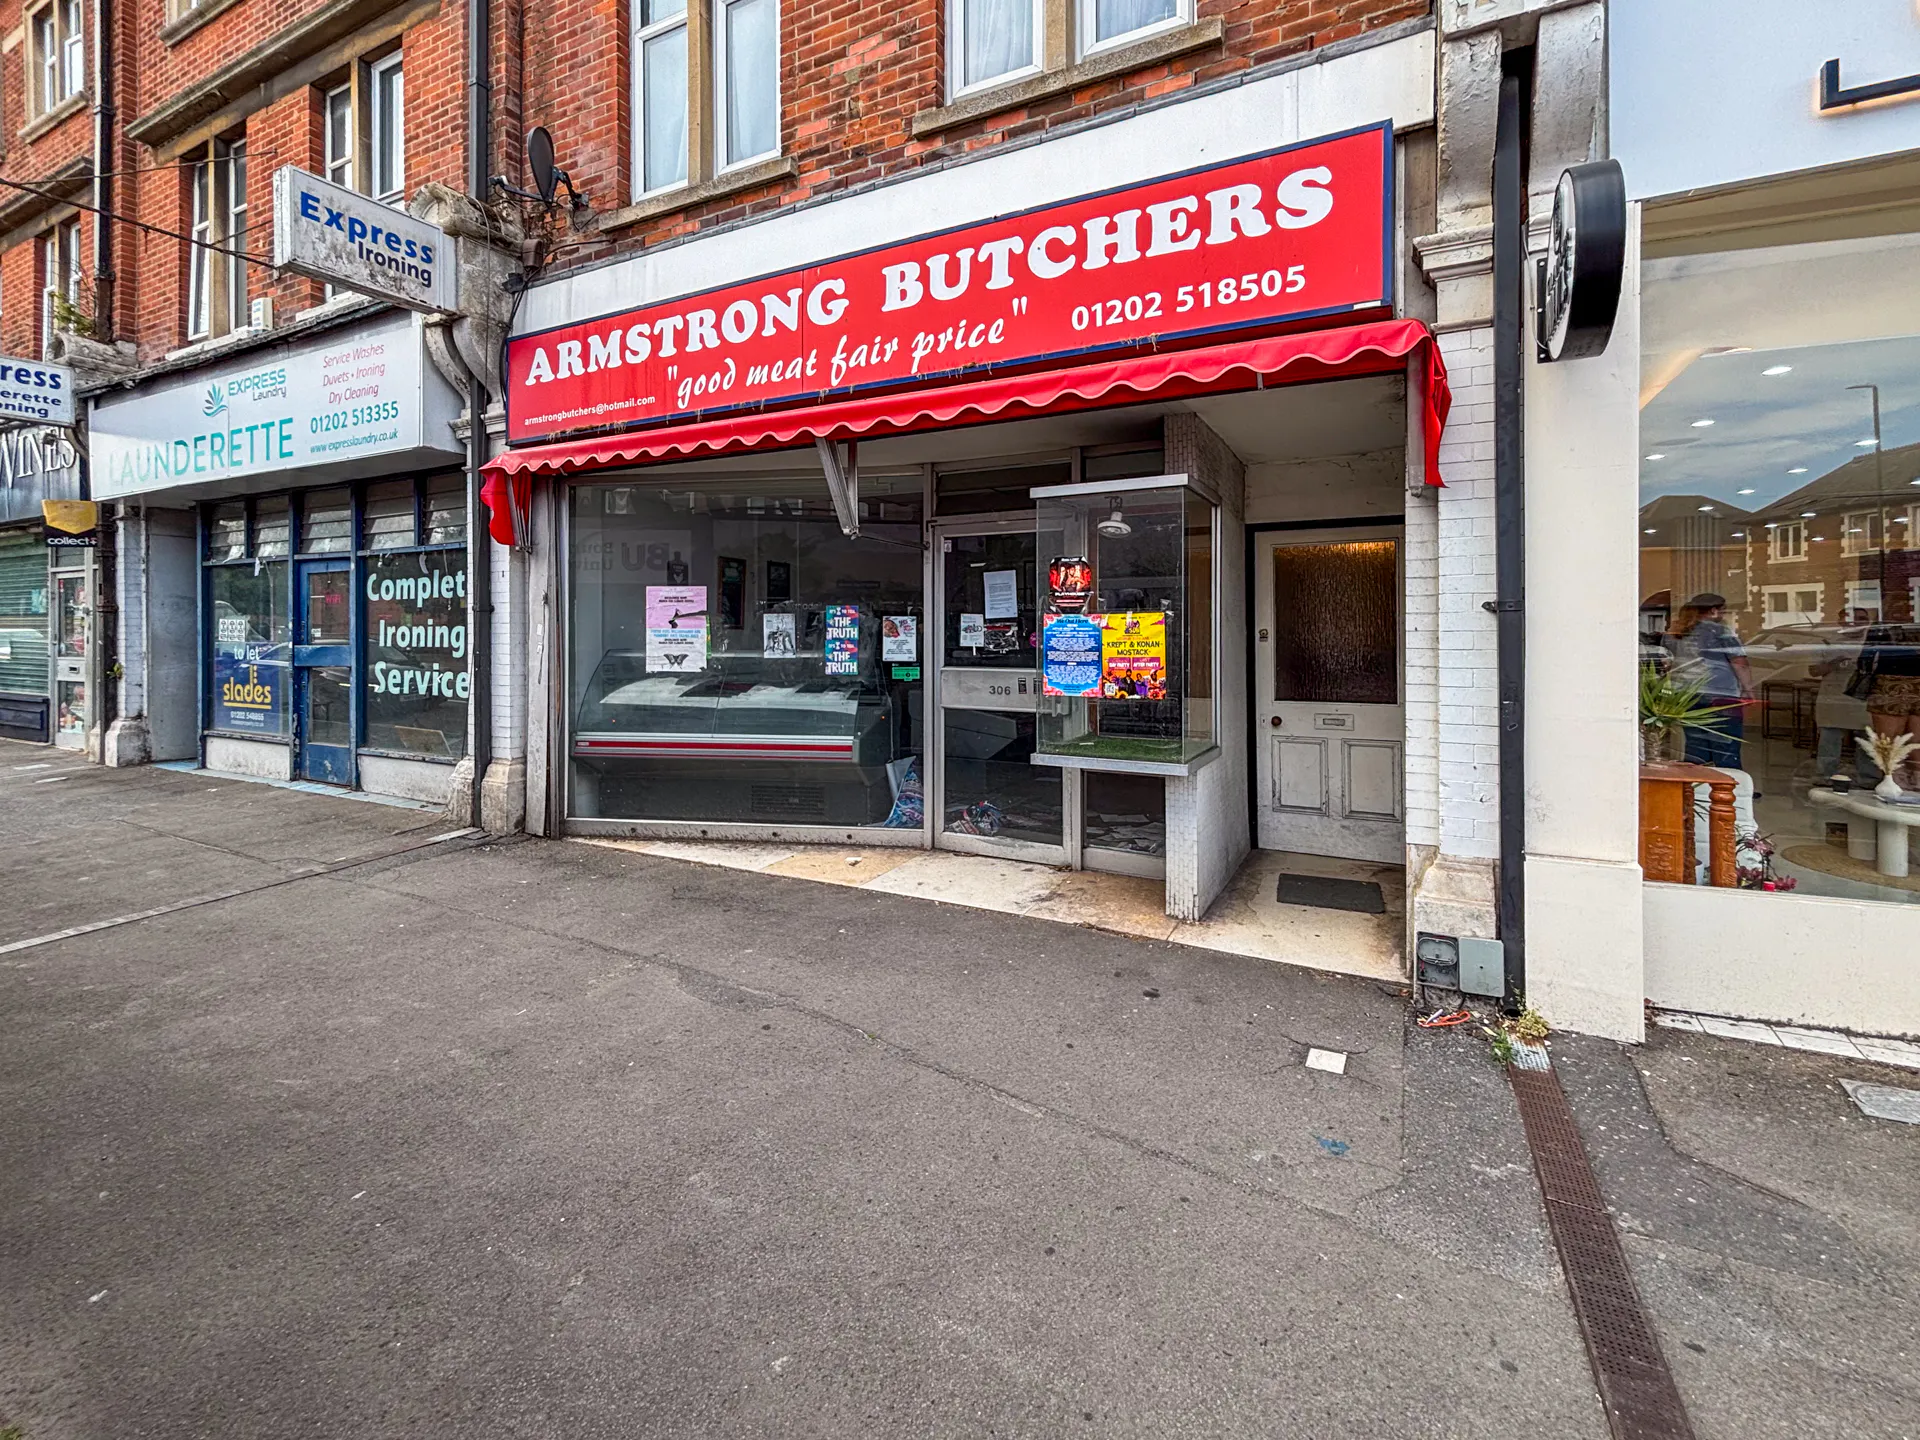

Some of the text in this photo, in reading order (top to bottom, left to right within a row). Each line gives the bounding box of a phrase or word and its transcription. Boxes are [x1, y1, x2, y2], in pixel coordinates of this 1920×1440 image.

[300, 191, 433, 264] Express
[359, 242, 432, 288] Ironing
[525, 165, 1333, 386] ARMSTRONG BUTCHERS
[1071, 265, 1307, 331] 01202 518505
[323, 344, 385, 368] Service Washes
[228, 368, 287, 396] EXPRESS
[323, 363, 386, 386] Duvets Ironing
[667, 357, 736, 410] "good
[747, 347, 817, 388] meat
[830, 334, 899, 386] fair
[253, 386, 287, 401] Laundry
[329, 384, 379, 404] Dry Cleaning
[0, 402, 49, 418] ning
[310, 401, 399, 434] 01202 513355
[524, 393, 656, 426] armstrongbutchers@hotmail.com
[109, 417, 294, 486] LAUNDERETTE
[367, 570, 466, 607] Complet
[827, 628, 858, 638] TRUTH
[834, 617, 851, 627] THE
[234, 645, 260, 660] to let
[379, 619, 466, 658] Ironing
[826, 662, 857, 673] TRUTH
[833, 652, 850, 661] THE
[223, 665, 272, 703] slades
[374, 661, 470, 699] Service
[989, 685, 1011, 696] 306
